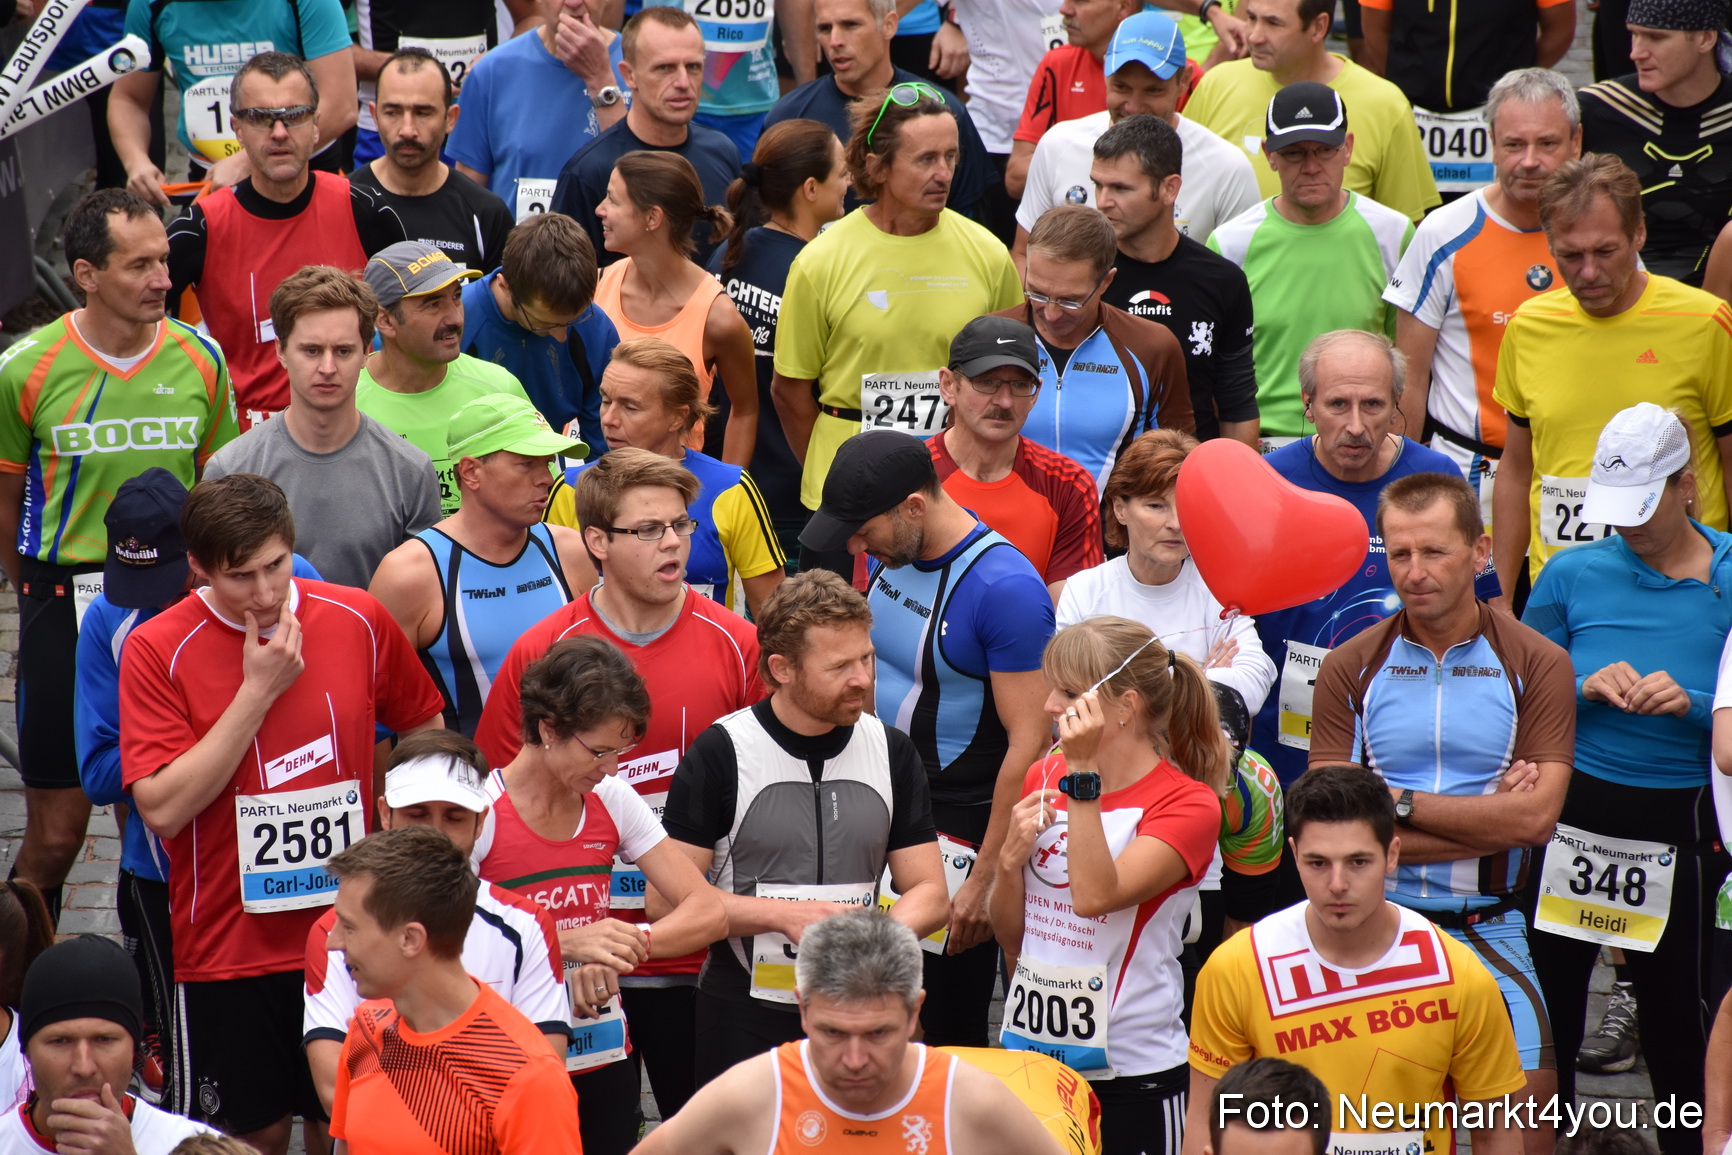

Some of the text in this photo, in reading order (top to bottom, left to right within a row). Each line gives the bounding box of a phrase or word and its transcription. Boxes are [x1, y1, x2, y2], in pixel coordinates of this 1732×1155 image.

[13, 0, 74, 84] Laufspor
[717, 27, 744, 40] Rico
[43, 66, 102, 110] BMW
[187, 86, 219, 97] PARTL
[724, 278, 783, 317] CHTER
[733, 302, 752, 316] ERIE
[754, 311, 760, 319] &
[1128, 304, 1172, 316] skinfit
[865, 380, 901, 390] PARTL
[52, 417, 199, 457] BOCK
[1543, 486, 1565, 498] PARTL
[78, 583, 104, 594] PAR
[1478, 667, 1502, 678] RACER
[285, 750, 315, 773] DEHN
[628, 761, 660, 779] DEHN
[240, 796, 342, 817] PARTL Neumarkt
[253, 811, 351, 866] 2581
[1551, 832, 1653, 863] PARTL Neumarkt
[1569, 855, 1647, 907] 348
[527, 883, 593, 912] SCAT
[1053, 901, 1073, 915] MIT
[1034, 912, 1049, 925] Heck
[1056, 918, 1067, 930] Dr.
[1068, 920, 1096, 937] Röschl
[1579, 909, 1628, 934] Heidi
[1025, 928, 1094, 951] eistungsdiagnostik
[1032, 972, 1083, 990] Neumarkt
[1012, 984, 1096, 1040] 2003
[1274, 998, 1458, 1055] MAX BÖGL
